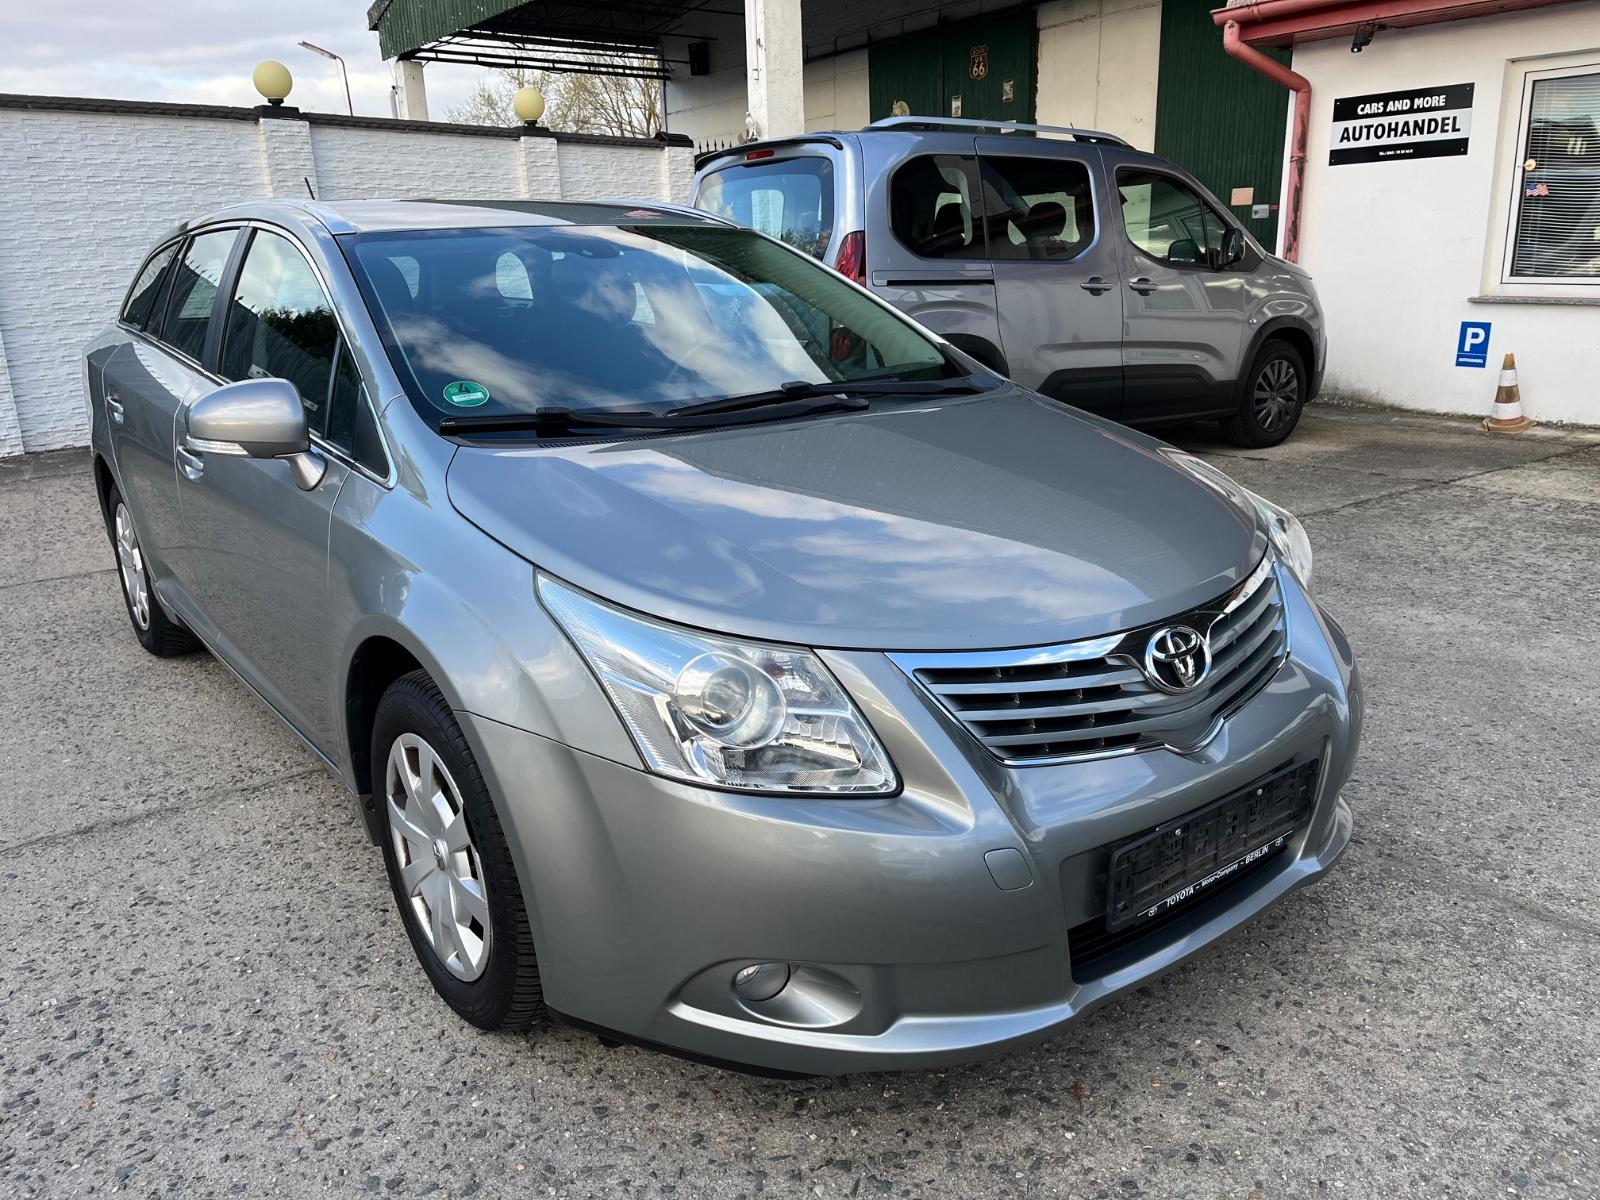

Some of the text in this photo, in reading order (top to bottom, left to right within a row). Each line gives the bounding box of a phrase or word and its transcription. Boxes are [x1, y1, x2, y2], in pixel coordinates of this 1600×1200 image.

[973, 62, 985, 76] 66
[1357, 95, 1447, 115] CARS AND MORE
[1339, 116, 1461, 143] AUTOHANDEL
[1464, 327, 1486, 352] P
[458, 383, 471, 393] 4
[1166, 887, 1194, 907] TOYOTA
[1245, 845, 1269, 864] BERLIN
